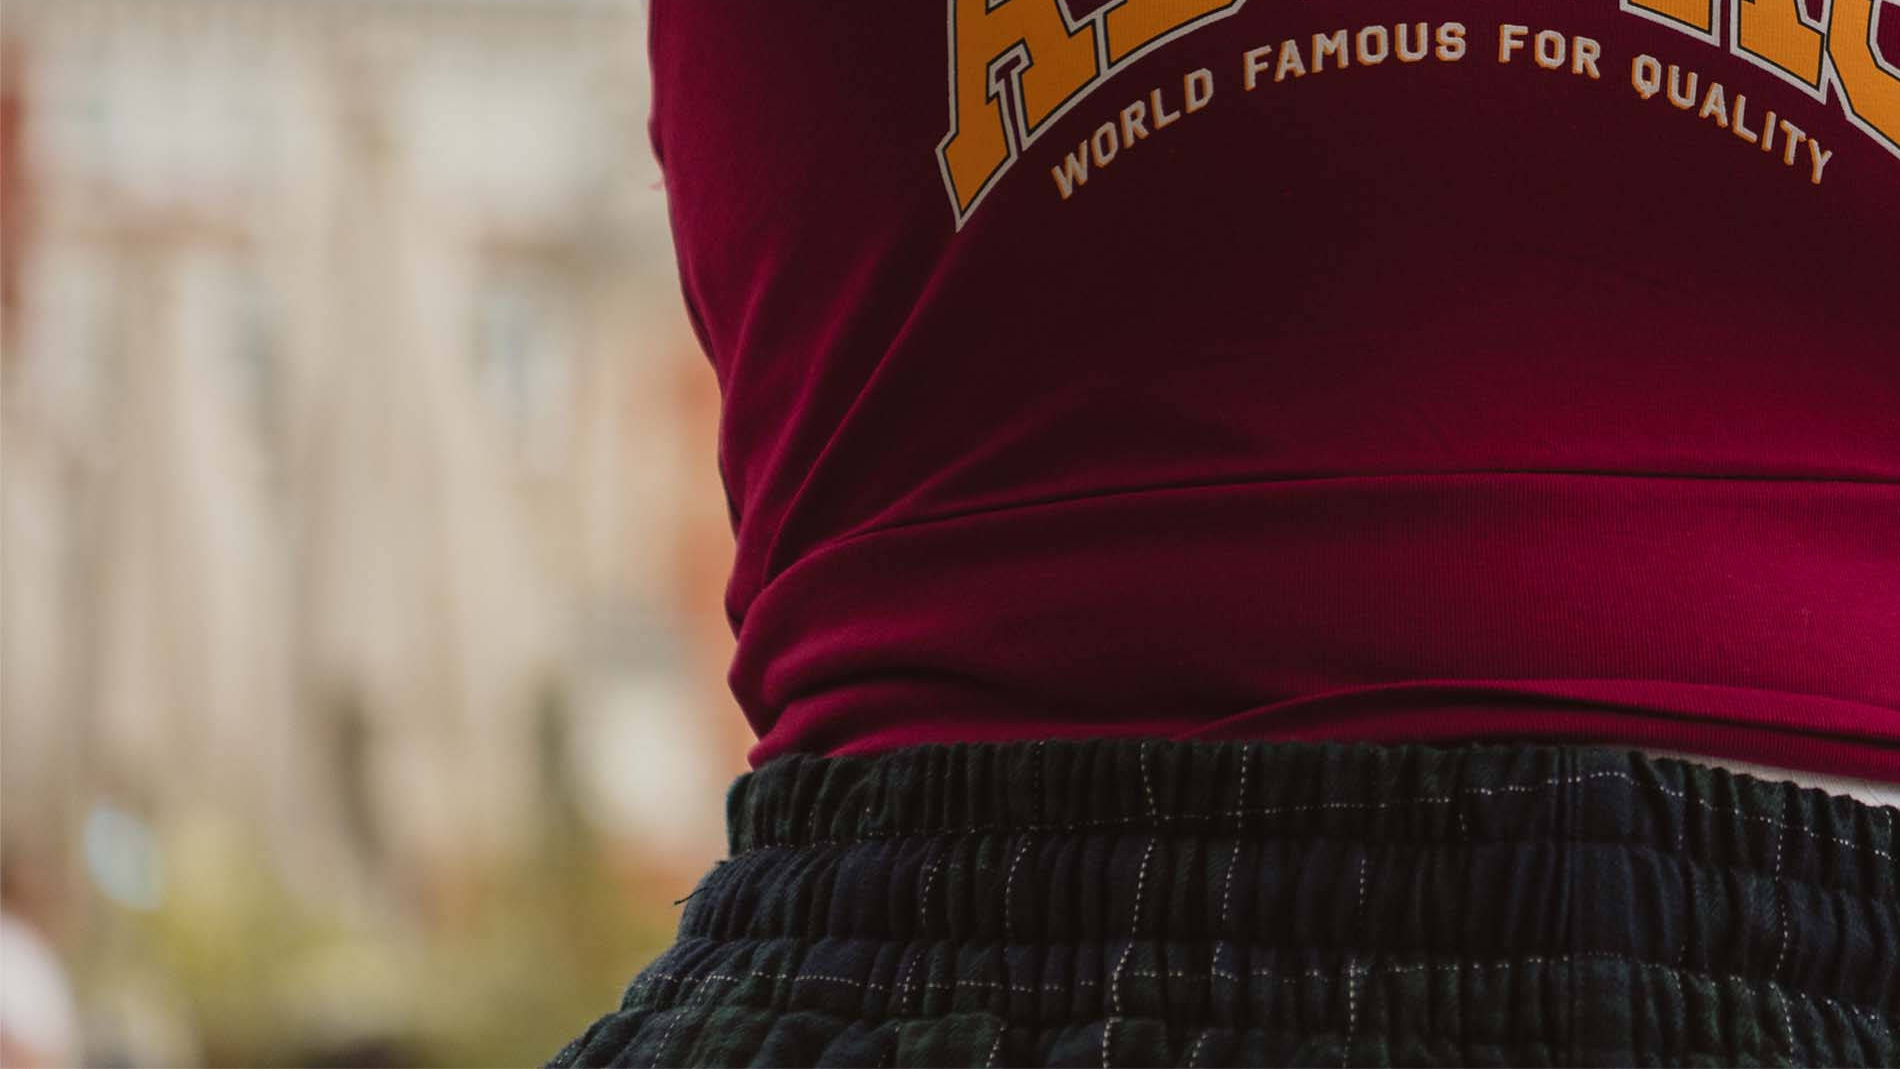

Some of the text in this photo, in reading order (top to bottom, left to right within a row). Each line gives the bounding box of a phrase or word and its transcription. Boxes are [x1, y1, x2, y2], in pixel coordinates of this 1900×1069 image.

[1050, 21, 1834, 201] WORLD FAMOUS FOR QUALITY
